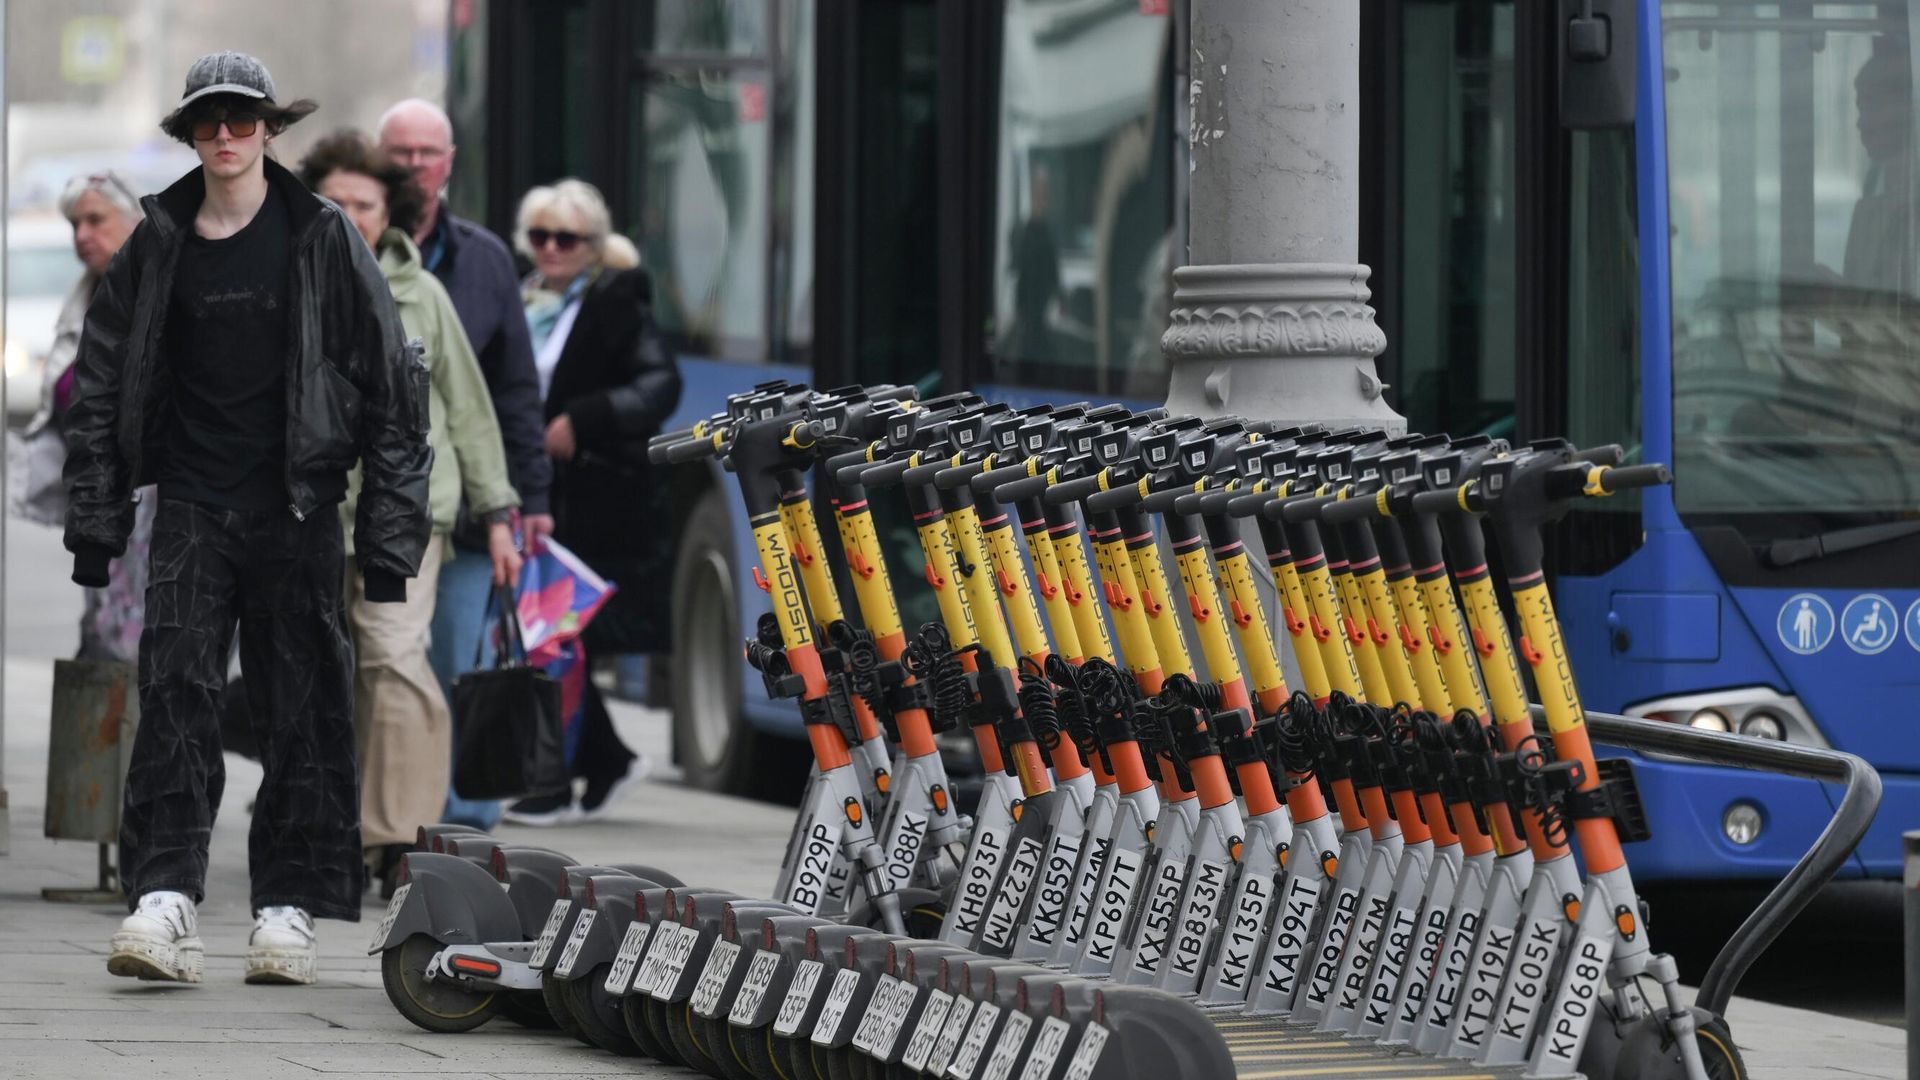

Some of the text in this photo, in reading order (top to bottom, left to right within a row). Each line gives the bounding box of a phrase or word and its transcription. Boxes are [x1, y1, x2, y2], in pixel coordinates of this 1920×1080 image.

[767, 533, 810, 644] WHOOSH
[793, 824, 835, 915] B929P
[956, 832, 1001, 934] KH893P
[984, 841, 1042, 945] KE221M
[1029, 836, 1077, 944] KK859T
[1090, 856, 1136, 959] KP697T
[1136, 865, 1182, 972] KX555P
[1174, 864, 1223, 974] KB833M
[609, 957, 634, 985] 59T
[620, 927, 646, 956] KK8
[655, 964, 681, 995] 97T
[668, 934, 695, 963] KP6
[745, 956, 775, 987] KB8
[791, 963, 820, 993] KK1
[1220, 879, 1267, 988] KK135P
[1265, 879, 1317, 992] KA994T
[1365, 911, 1414, 1024] KP768T
[1500, 923, 1556, 1039] KT605K
[779, 995, 806, 1024] 35P
[816, 1007, 842, 1037] 94T
[830, 973, 857, 1003] KA9
[921, 996, 950, 1031] KP7
[1458, 929, 1512, 1046] KT919K
[1549, 943, 1604, 1059] KP068P
[907, 1029, 935, 1065] 68T
